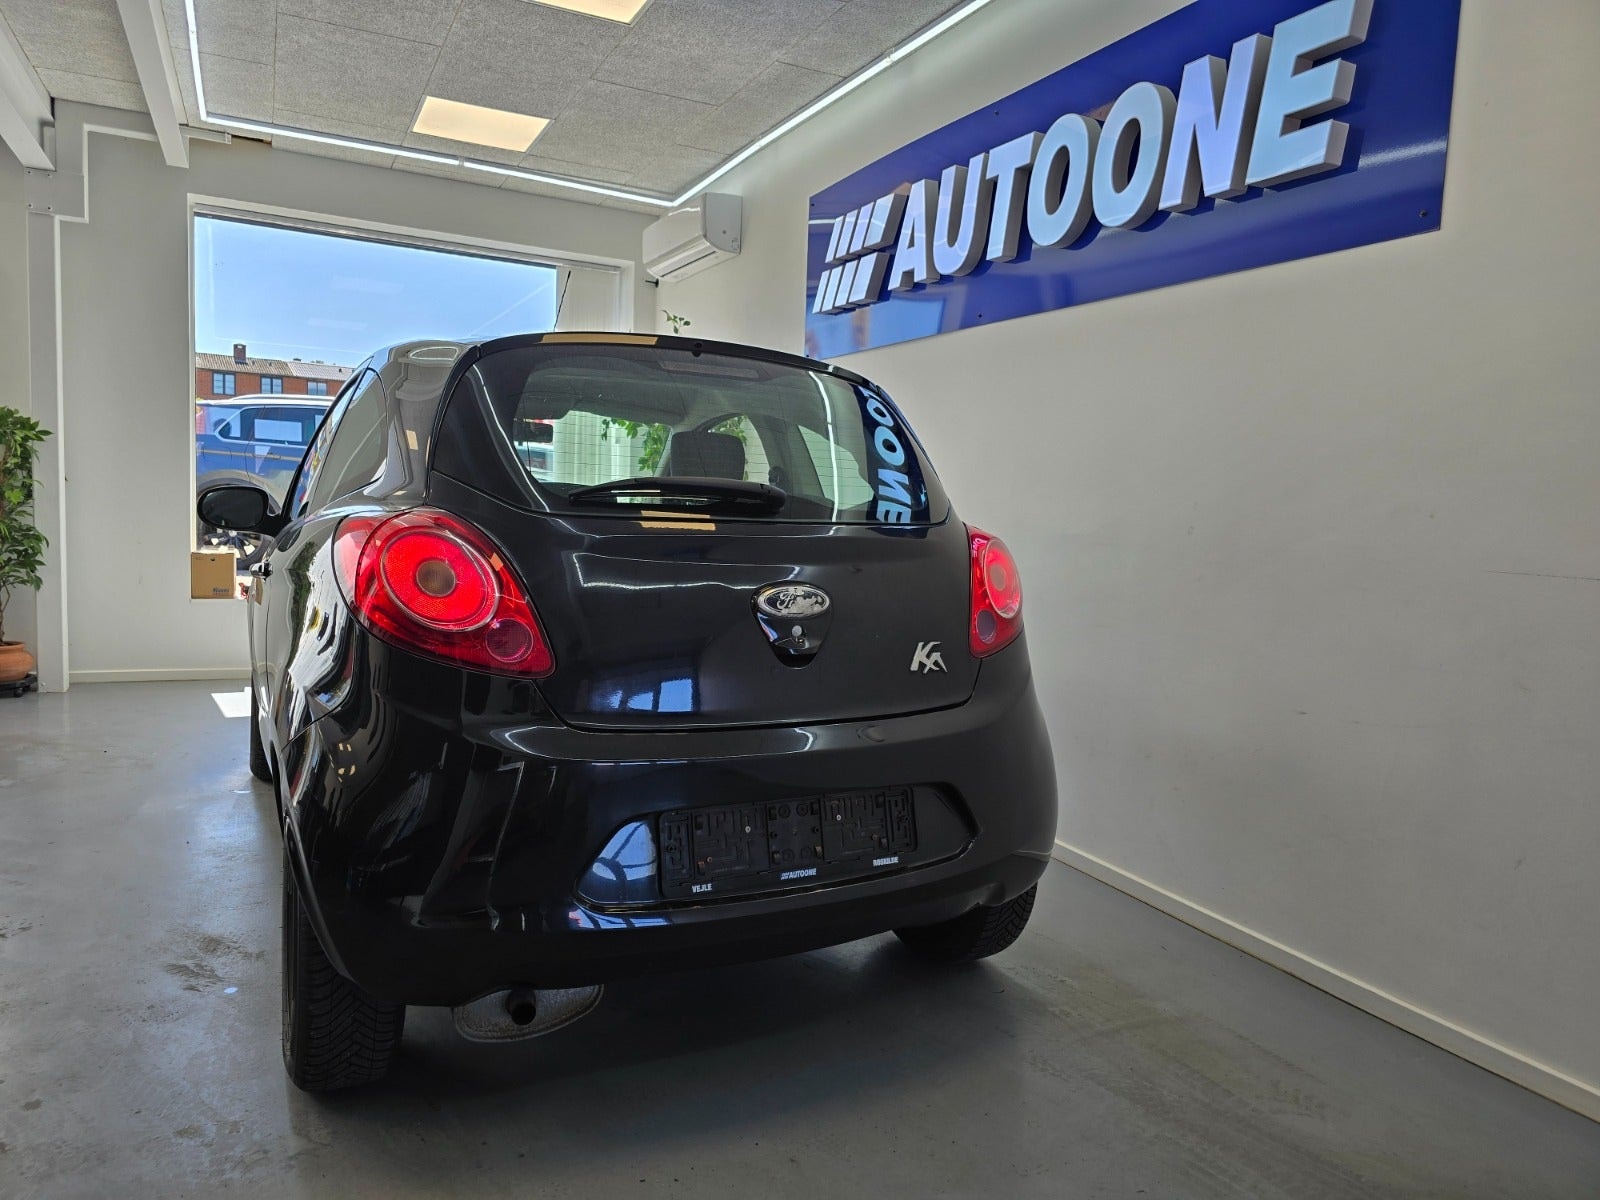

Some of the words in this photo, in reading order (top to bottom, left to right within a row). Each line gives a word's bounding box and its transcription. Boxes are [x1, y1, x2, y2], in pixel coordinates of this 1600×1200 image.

[888, 0, 1372, 292] AUTOONE
[691, 883, 713, 893] VEJLE
[788, 868, 817, 879] AUTOONE
